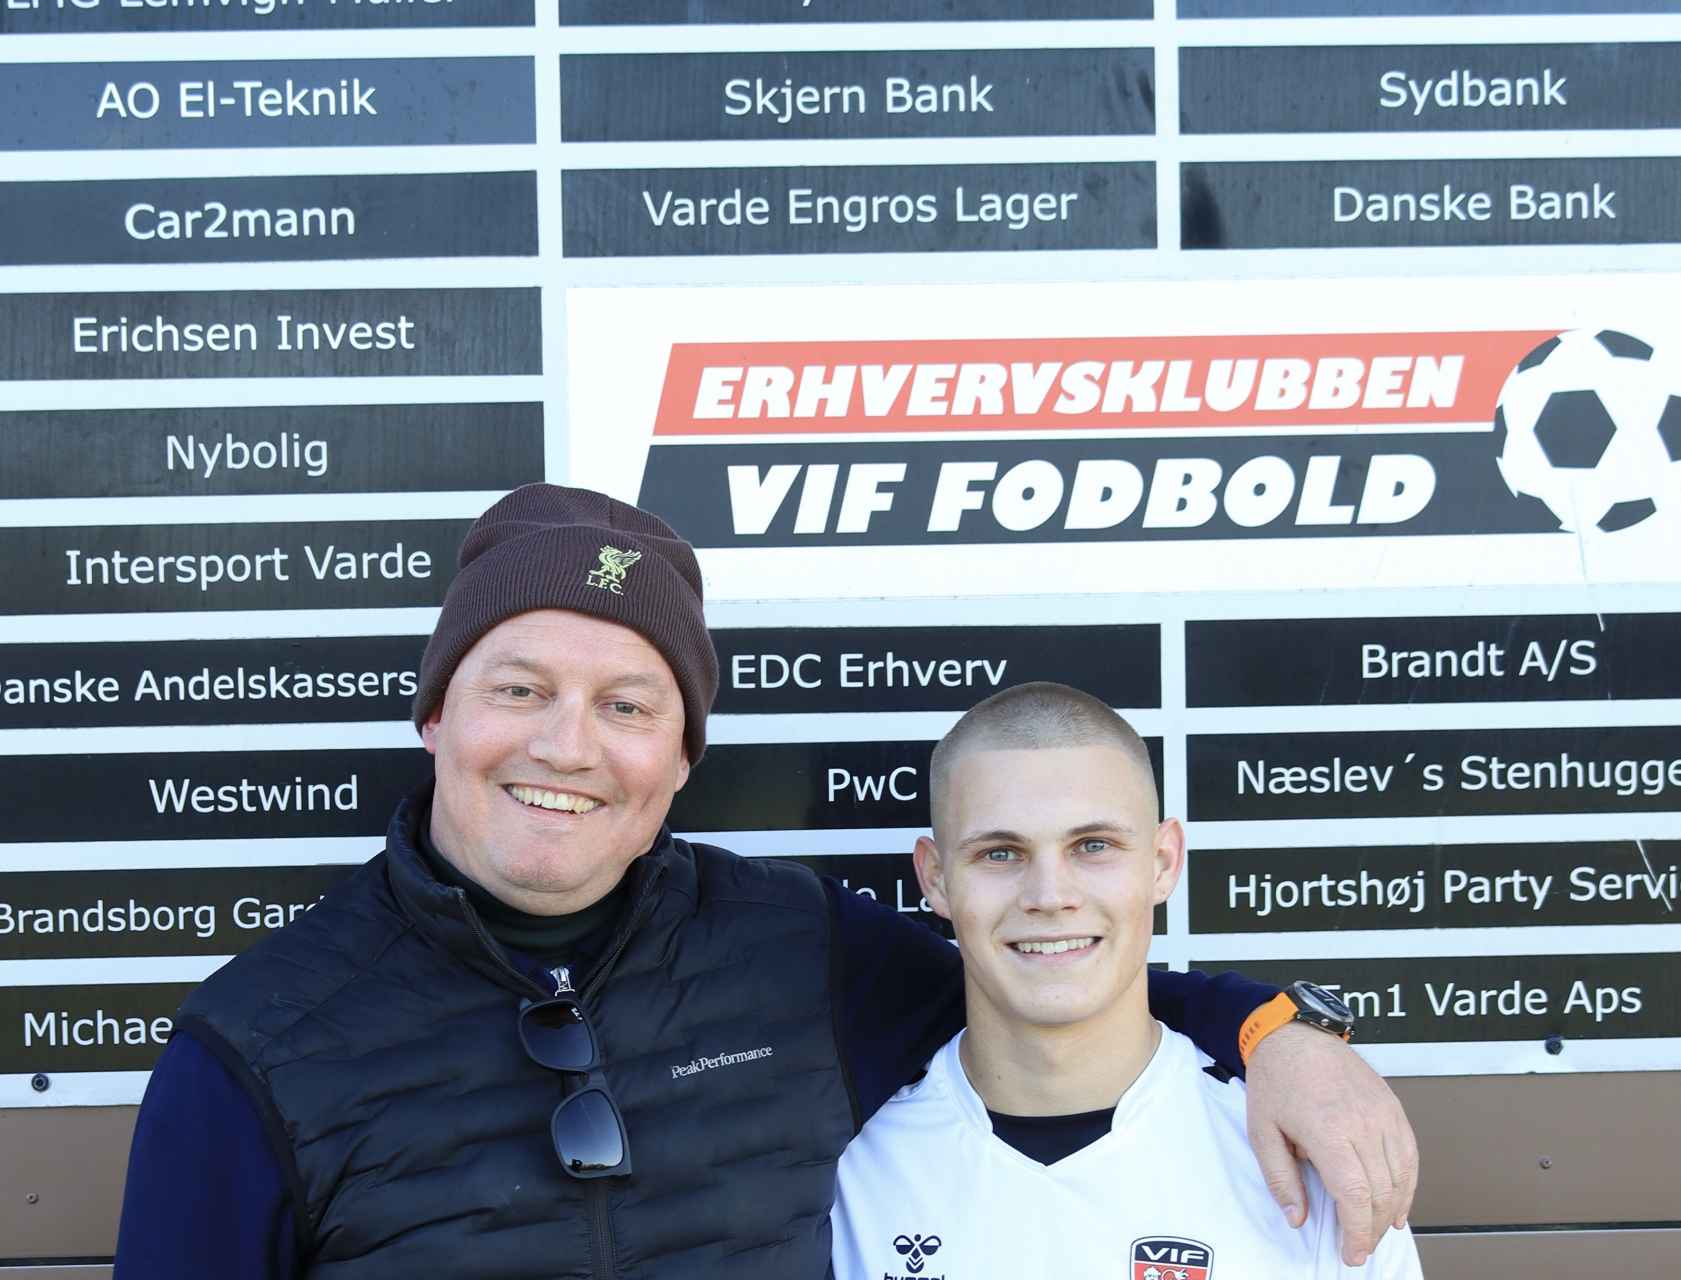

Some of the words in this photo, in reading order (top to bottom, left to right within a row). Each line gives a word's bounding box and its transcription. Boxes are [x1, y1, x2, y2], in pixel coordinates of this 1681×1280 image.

[96, 82, 160, 119] AO
[179, 78, 377, 118] El-Teknik
[725, 78, 866, 124] Skjern
[886, 75, 994, 113] Bank
[1380, 68, 1567, 116] Sydbank
[124, 201, 355, 240] Car2mann
[642, 188, 770, 226] Varde
[788, 187, 938, 233] Engros
[956, 186, 1078, 230] Lager
[1333, 184, 1492, 223] Danske
[1510, 182, 1616, 220] Bank
[73, 315, 257, 353] Erichsen
[277, 315, 415, 351] Invest
[692, 355, 1464, 420] ERHVERVSKLUBBEN
[167, 432, 328, 479] Nybolig
[727, 462, 908, 535] VIF
[926, 453, 1437, 533] FODBOLD
[65, 547, 289, 591] Intersport
[303, 542, 432, 580] Varde
[731, 653, 822, 689] EDC
[840, 651, 1007, 688] Erhverv
[1361, 640, 1505, 679] Brandt
[1518, 639, 1597, 682] A/S
[0, 670, 120, 704] anske
[134, 666, 418, 701] Andelskassers
[148, 774, 358, 813] Westwind
[828, 766, 917, 802] PwC
[1229, 870, 1425, 917] Hjortshøj
[1444, 869, 1553, 911] Party
[1569, 866, 1681, 902] Servi
[0, 898, 216, 938] Brandsborg
[232, 896, 325, 930] Gar
[1424, 979, 1548, 1017] Varde
[1563, 980, 1642, 1022] Aps
[24, 1009, 174, 1047] Michae
[1141, 1245, 1205, 1263] VIF
